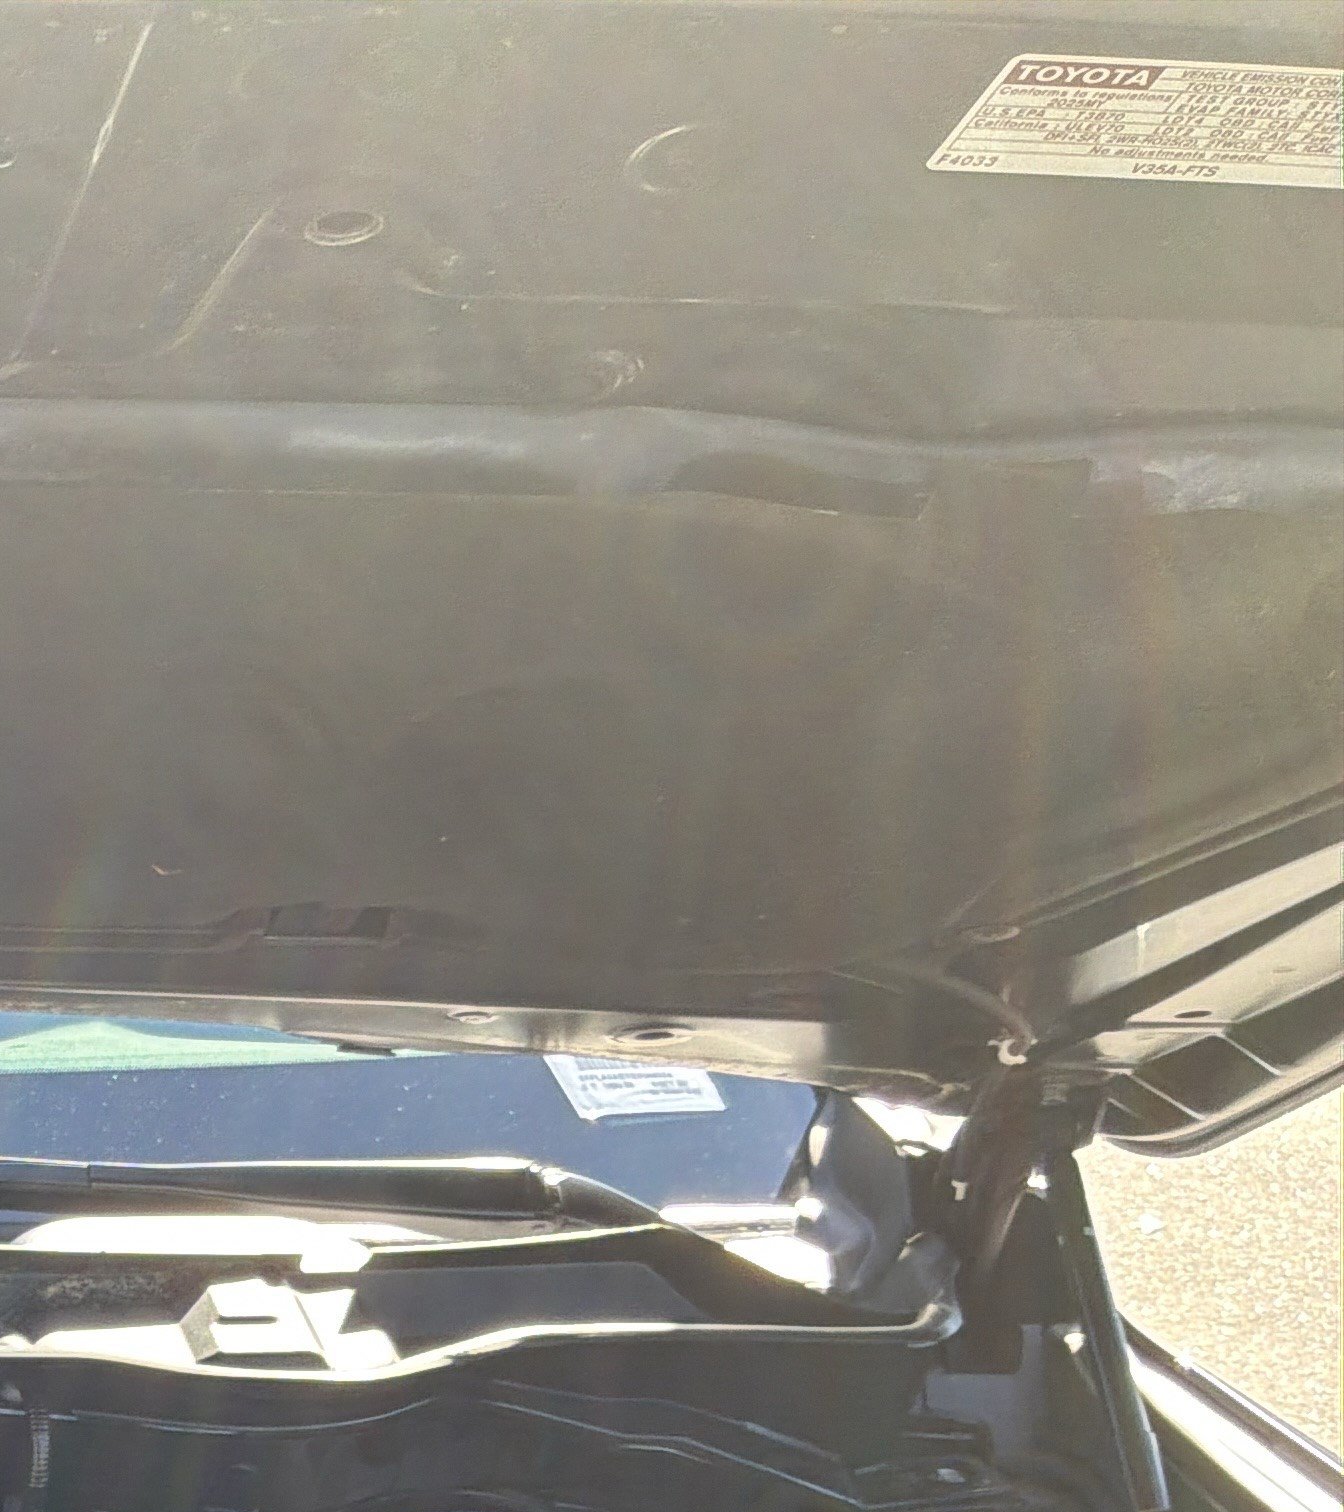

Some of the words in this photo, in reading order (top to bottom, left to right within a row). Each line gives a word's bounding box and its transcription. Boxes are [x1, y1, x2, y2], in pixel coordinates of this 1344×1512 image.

[1018, 64, 1150, 87] TOYOTA
[1182, 70, 1237, 81] VEHICLE
[1240, 72, 1308, 85] EMISSION
[999, 86, 1068, 98] Conforms
[1073, 89, 1088, 98] to
[1092, 90, 1174, 103] regulations
[1186, 82, 1243, 95] TOYOTA
[1247, 86, 1304, 98] MOTOR
[1046, 98, 1108, 109] 2025MY
[1186, 94, 1229, 105] TEST
[1233, 97, 1291, 107] GROUP
[1175, 103, 1220, 115] EVAP
[974, 117, 1049, 130] California
[1088, 145, 1110, 156] No
[1113, 147, 1206, 160] adjustments
[935, 154, 999, 168] F4033
[1131, 162, 1220, 178] V35A-FTS
